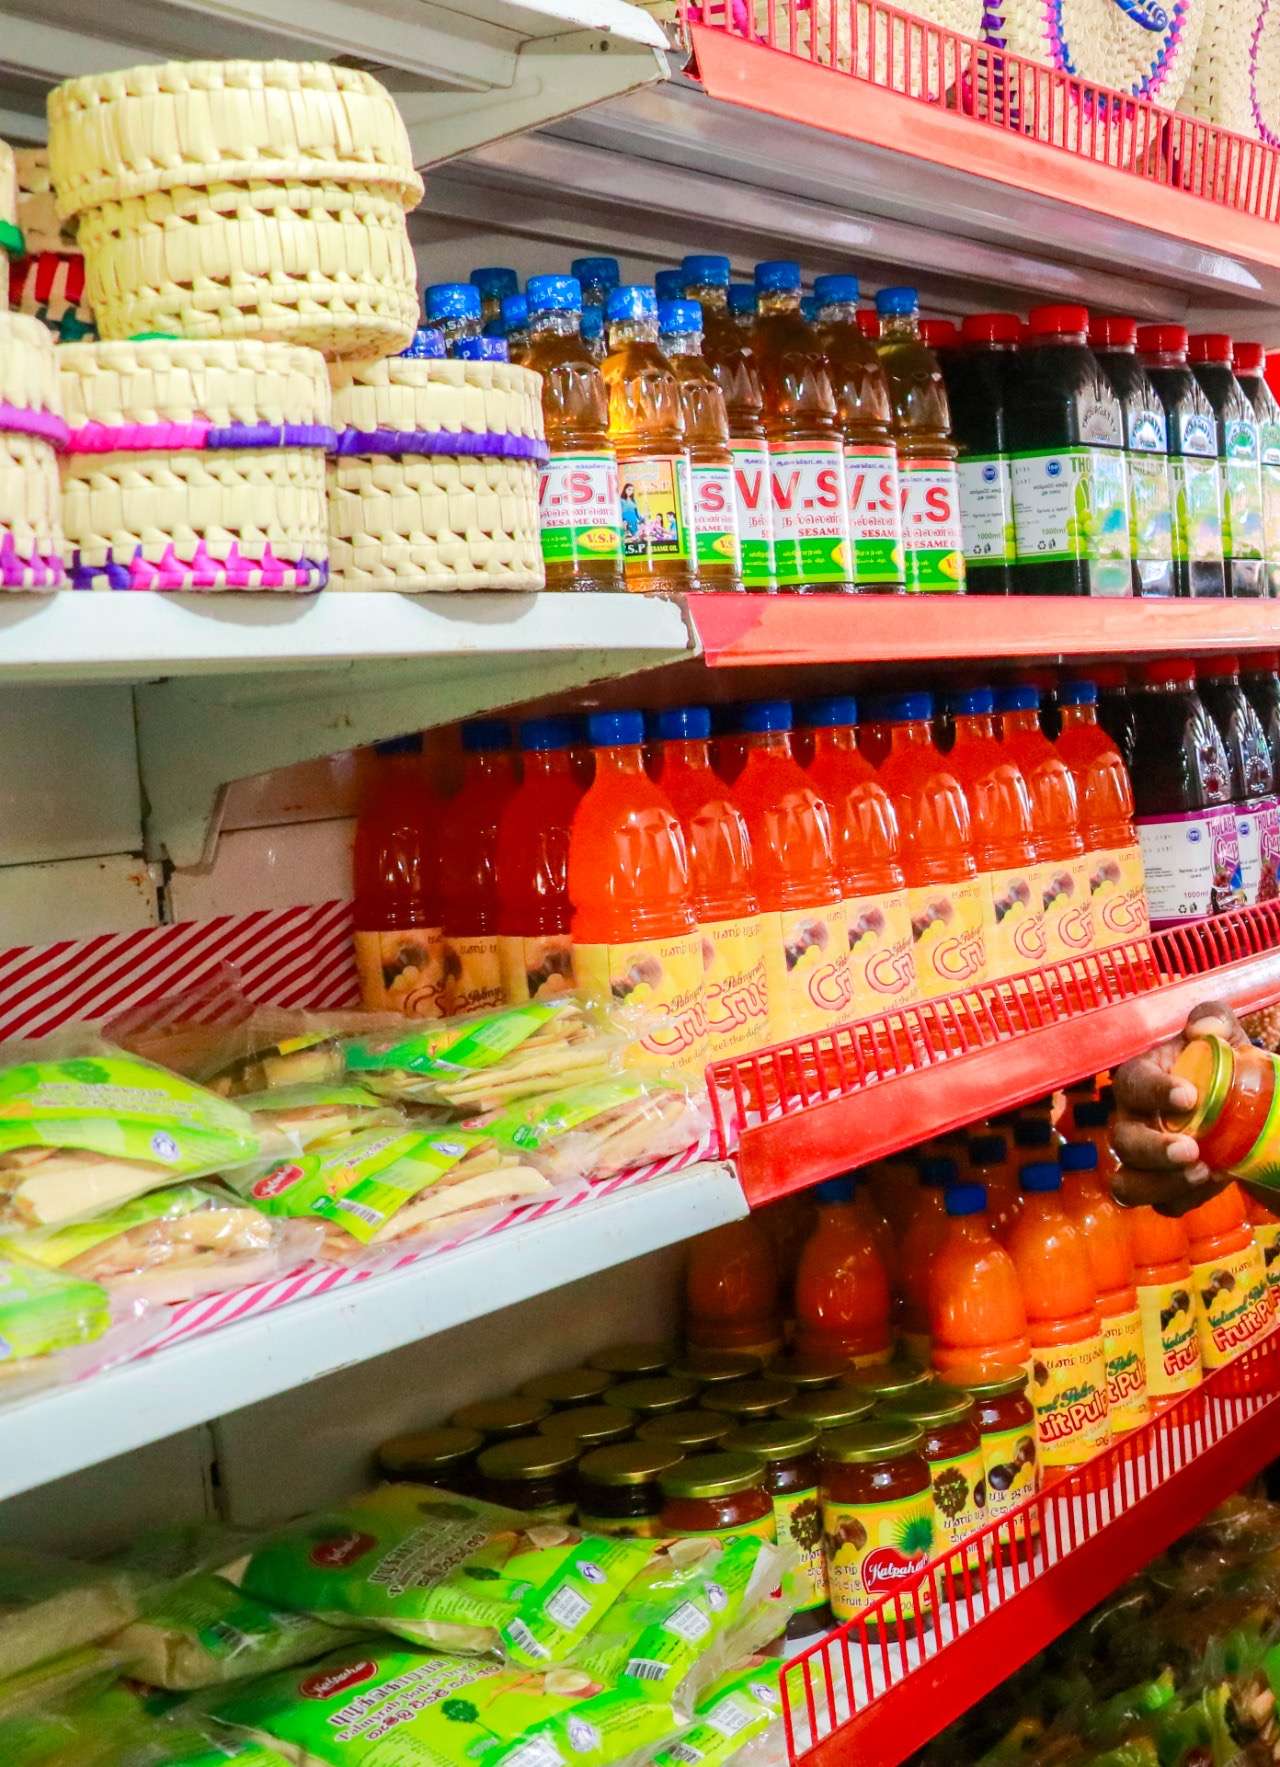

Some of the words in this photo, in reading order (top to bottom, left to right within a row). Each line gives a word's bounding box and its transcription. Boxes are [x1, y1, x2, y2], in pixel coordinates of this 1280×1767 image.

[735, 469, 763, 509] V
[771, 469, 841, 511] V.S
[592, 517, 608, 525] OIL
[861, 529, 897, 538] SESAM
[624, 543, 647, 555] .S.P
[640, 997, 708, 1056] Cru
[1212, 1310, 1260, 1352] Fruit
[1038, 1412, 1072, 1443] uit
